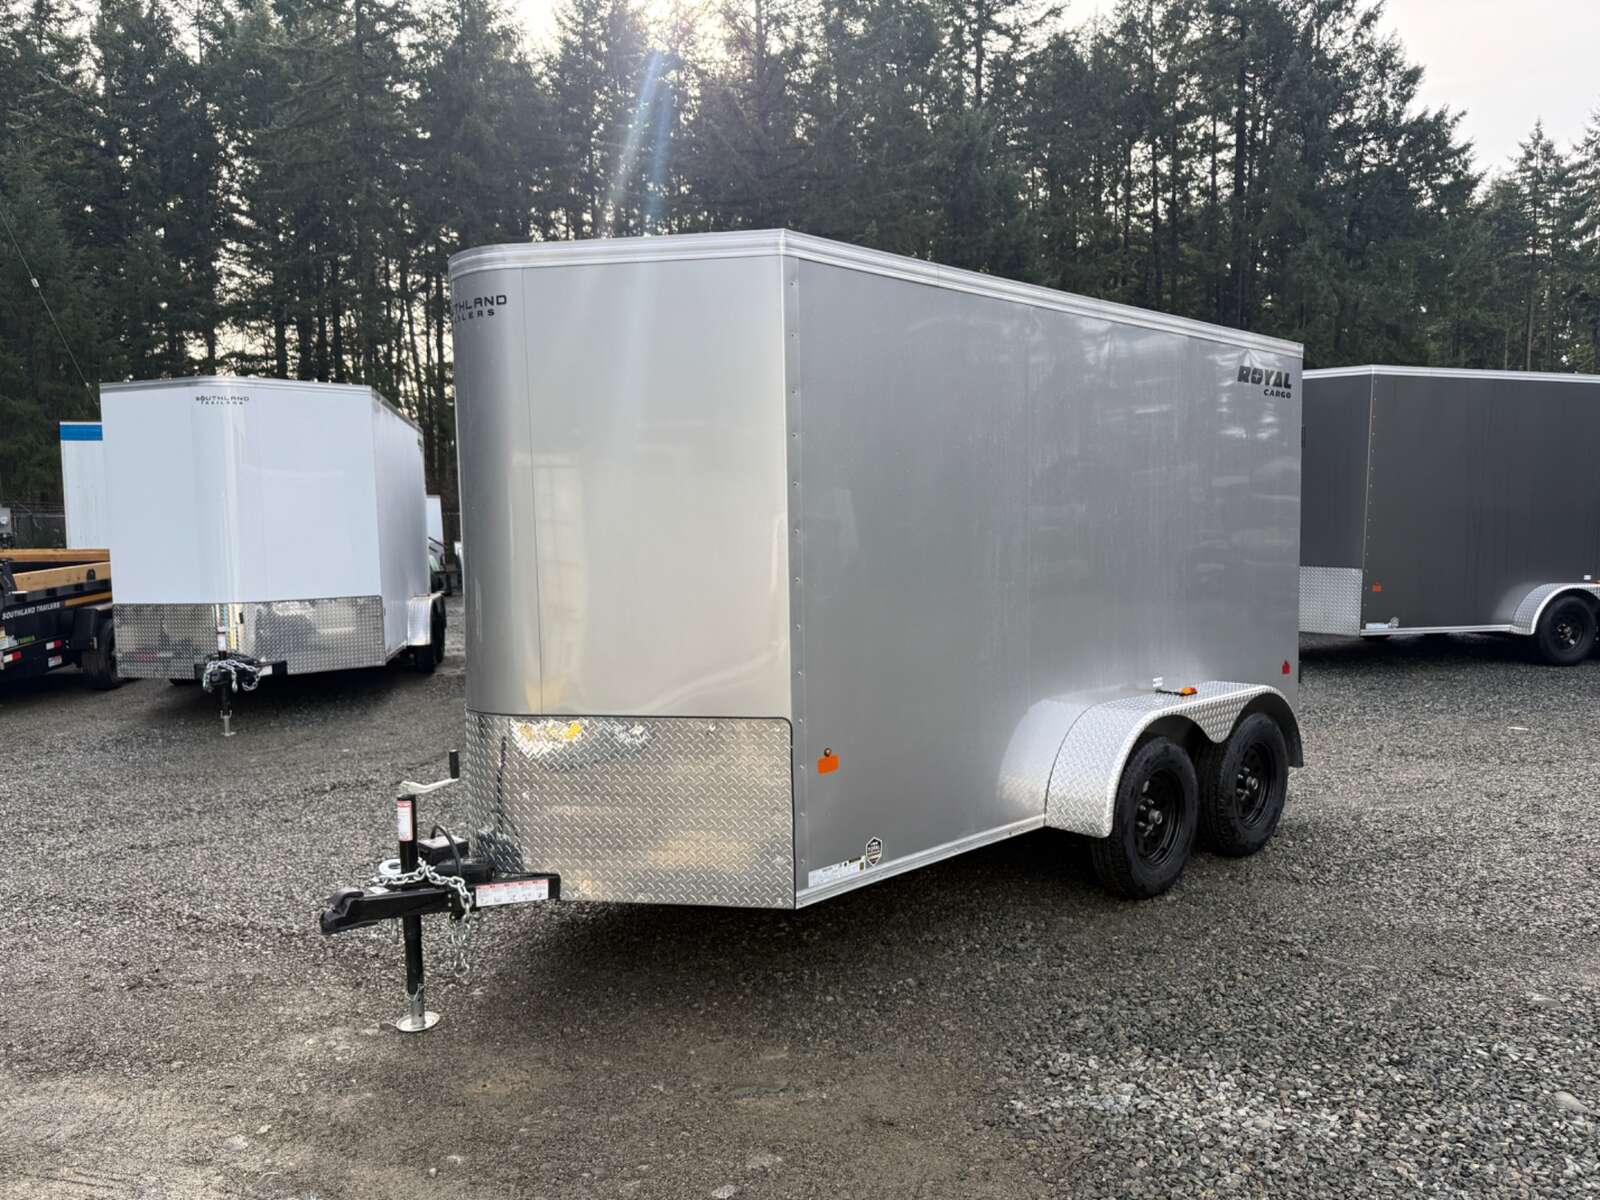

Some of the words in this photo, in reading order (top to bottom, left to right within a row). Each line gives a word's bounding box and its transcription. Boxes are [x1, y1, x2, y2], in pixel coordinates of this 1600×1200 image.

[1237, 365, 1292, 389] ROYAL
[1263, 389, 1292, 399] CARGO
[2, 606, 35, 620] SOUTHLAND
